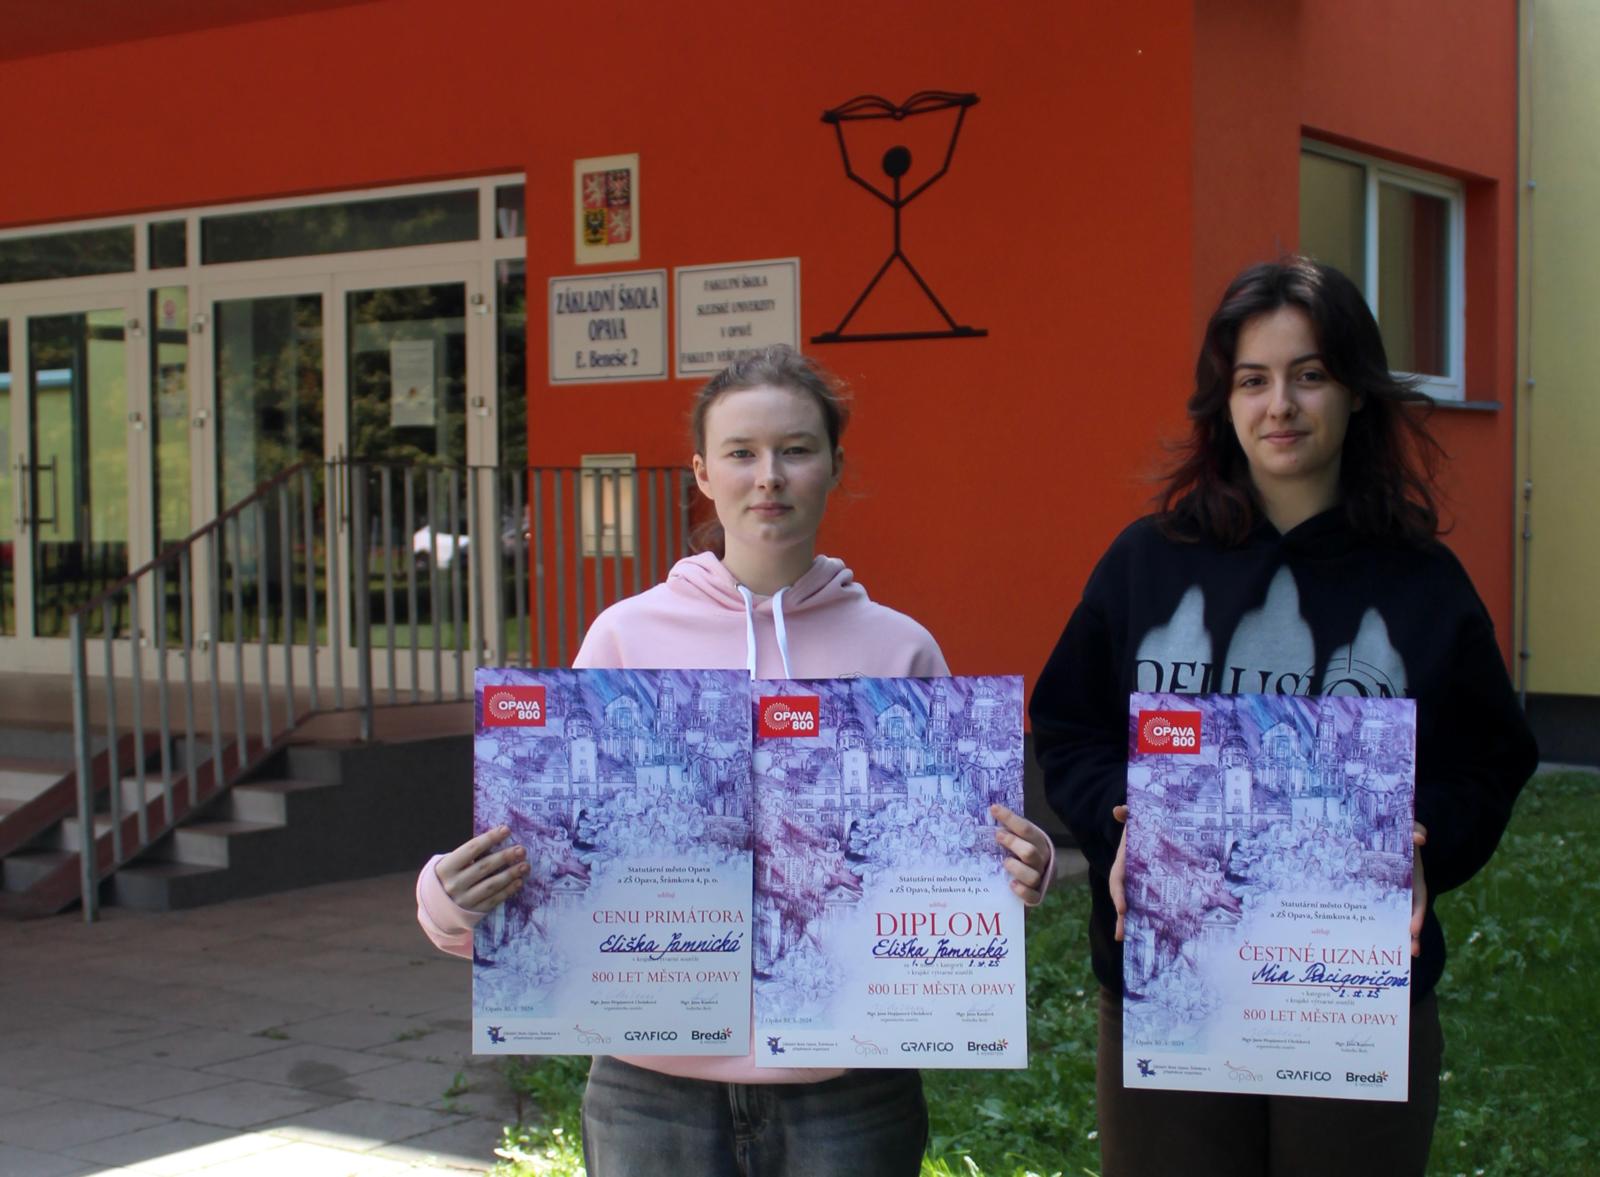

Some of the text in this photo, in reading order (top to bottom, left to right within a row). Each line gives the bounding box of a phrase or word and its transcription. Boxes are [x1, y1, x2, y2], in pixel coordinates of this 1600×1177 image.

[556, 284, 658, 314] ZÁKLADNÍ ŠKOLA
[588, 318, 627, 341] OPAVA
[589, 348, 628, 368] Beneše
[630, 348, 638, 366] 2
[498, 701, 540, 710] OPAVA
[518, 710, 540, 720] 800
[773, 711, 814, 721] OPAVA
[792, 720, 814, 730] 800
[1153, 726, 1195, 736] OPAVA
[1172, 736, 1195, 747] 800
[628, 866, 664, 874] Statutární
[688, 867, 711, 875] Opava
[623, 876, 633, 884] ZŠ
[660, 876, 695, 884] Šrámkova
[959, 876, 981, 884] Opava
[931, 885, 965, 893] Šrámkova
[1281, 900, 1318, 909] Statutární
[1343, 903, 1367, 911] Opava
[592, 905, 744, 924] CENU PRIMÁTORA
[1314, 911, 1350, 920] Šrámkova
[876, 912, 1002, 937] DIPLOM
[599, 931, 744, 960] Eliška Jamnická
[872, 938, 1009, 965] Eliška Jamnická
[1239, 941, 1402, 966] ČESTNÉ UZNÁNÍ
[592, 969, 740, 983] 800 LET MĚSTA OPAVY
[1252, 962, 1295, 982] Mia
[868, 981, 1015, 995] 800 LET MĚSTA OPAVY
[1243, 1008, 1398, 1026] 800 LET MĚSTA OPAVY
[624, 1031, 677, 1041] GRAFICO
[692, 1031, 727, 1041] Breda
[901, 1042, 953, 1051] GRAFICO
[968, 1041, 1003, 1051] Breda
[1276, 1070, 1331, 1081] GRAFICO
[1346, 1072, 1383, 1083] Breda
